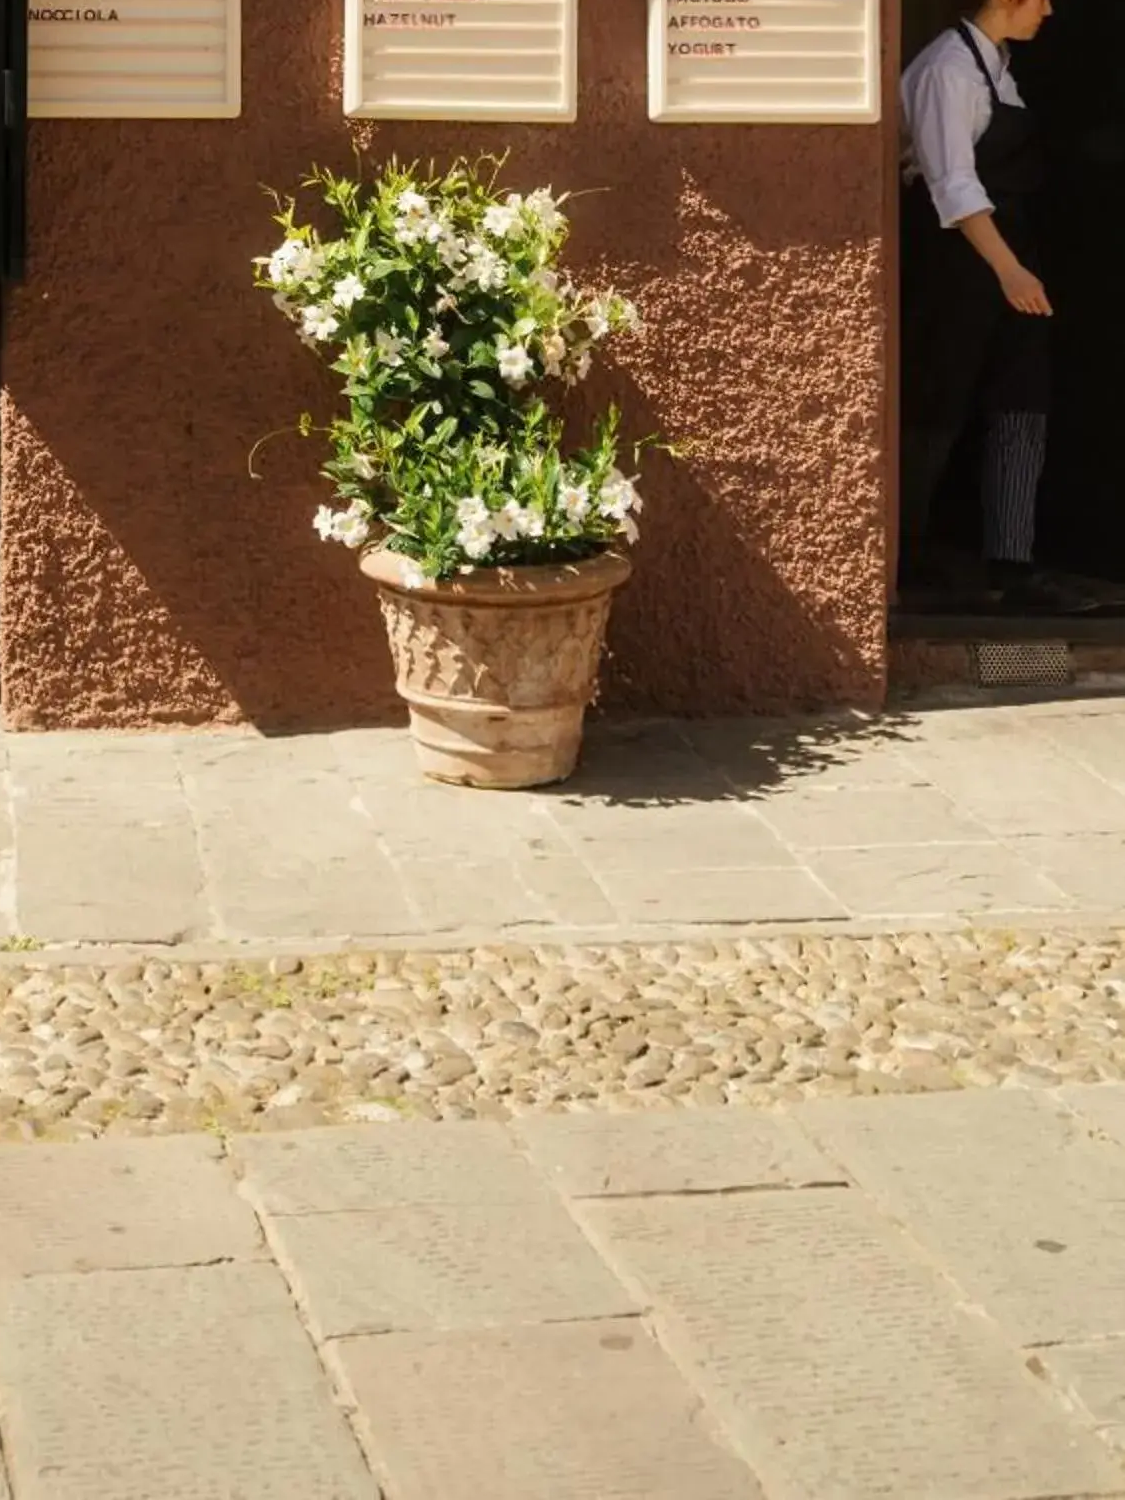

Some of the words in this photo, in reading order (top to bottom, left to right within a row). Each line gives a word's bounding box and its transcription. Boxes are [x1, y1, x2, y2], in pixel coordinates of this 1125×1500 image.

[363, 13, 456, 27] HAZELNUT
[668, 16, 760, 30] AFFOGATO
[668, 43, 736, 56] YOGURT
